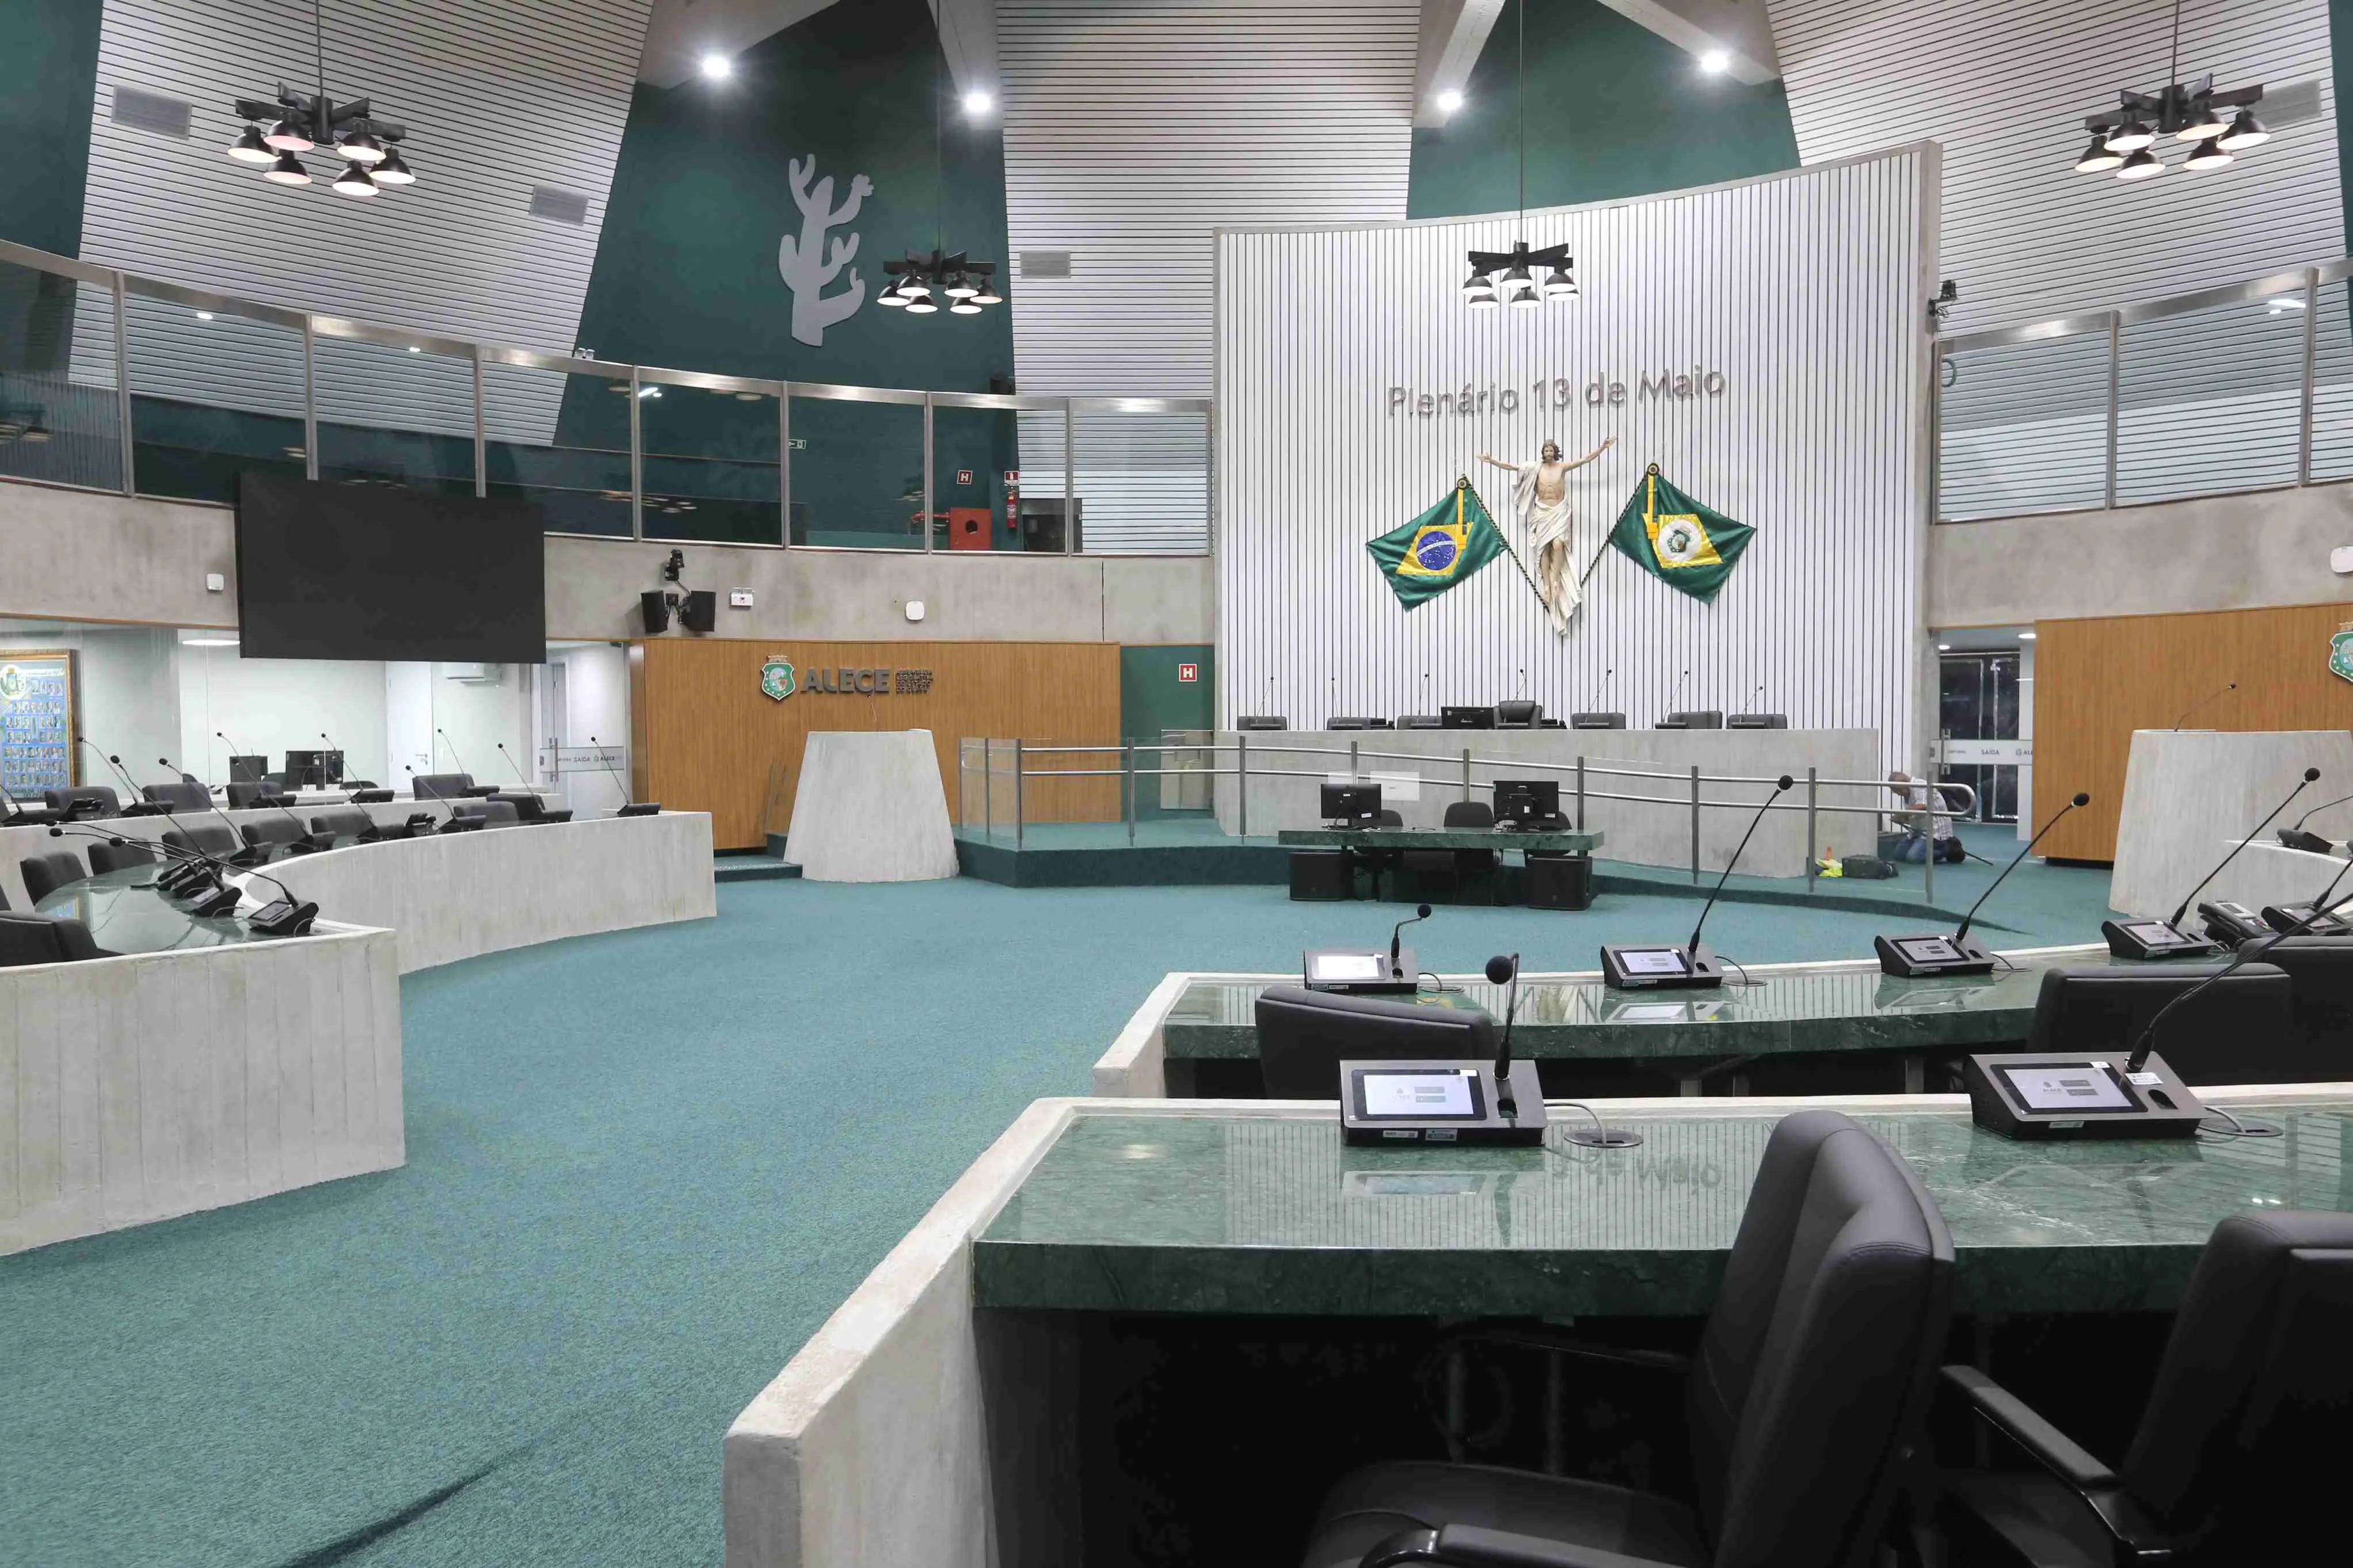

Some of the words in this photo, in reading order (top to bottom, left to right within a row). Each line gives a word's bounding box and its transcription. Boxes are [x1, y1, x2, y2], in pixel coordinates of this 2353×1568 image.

[1388, 382, 1519, 417] Plenário
[1533, 377, 1572, 410] 13
[1585, 372, 1627, 409] de
[1639, 364, 1726, 404] Maio
[961, 473, 969, 482] H
[802, 667, 890, 693] ALECE
[1183, 667, 1193, 678] H
